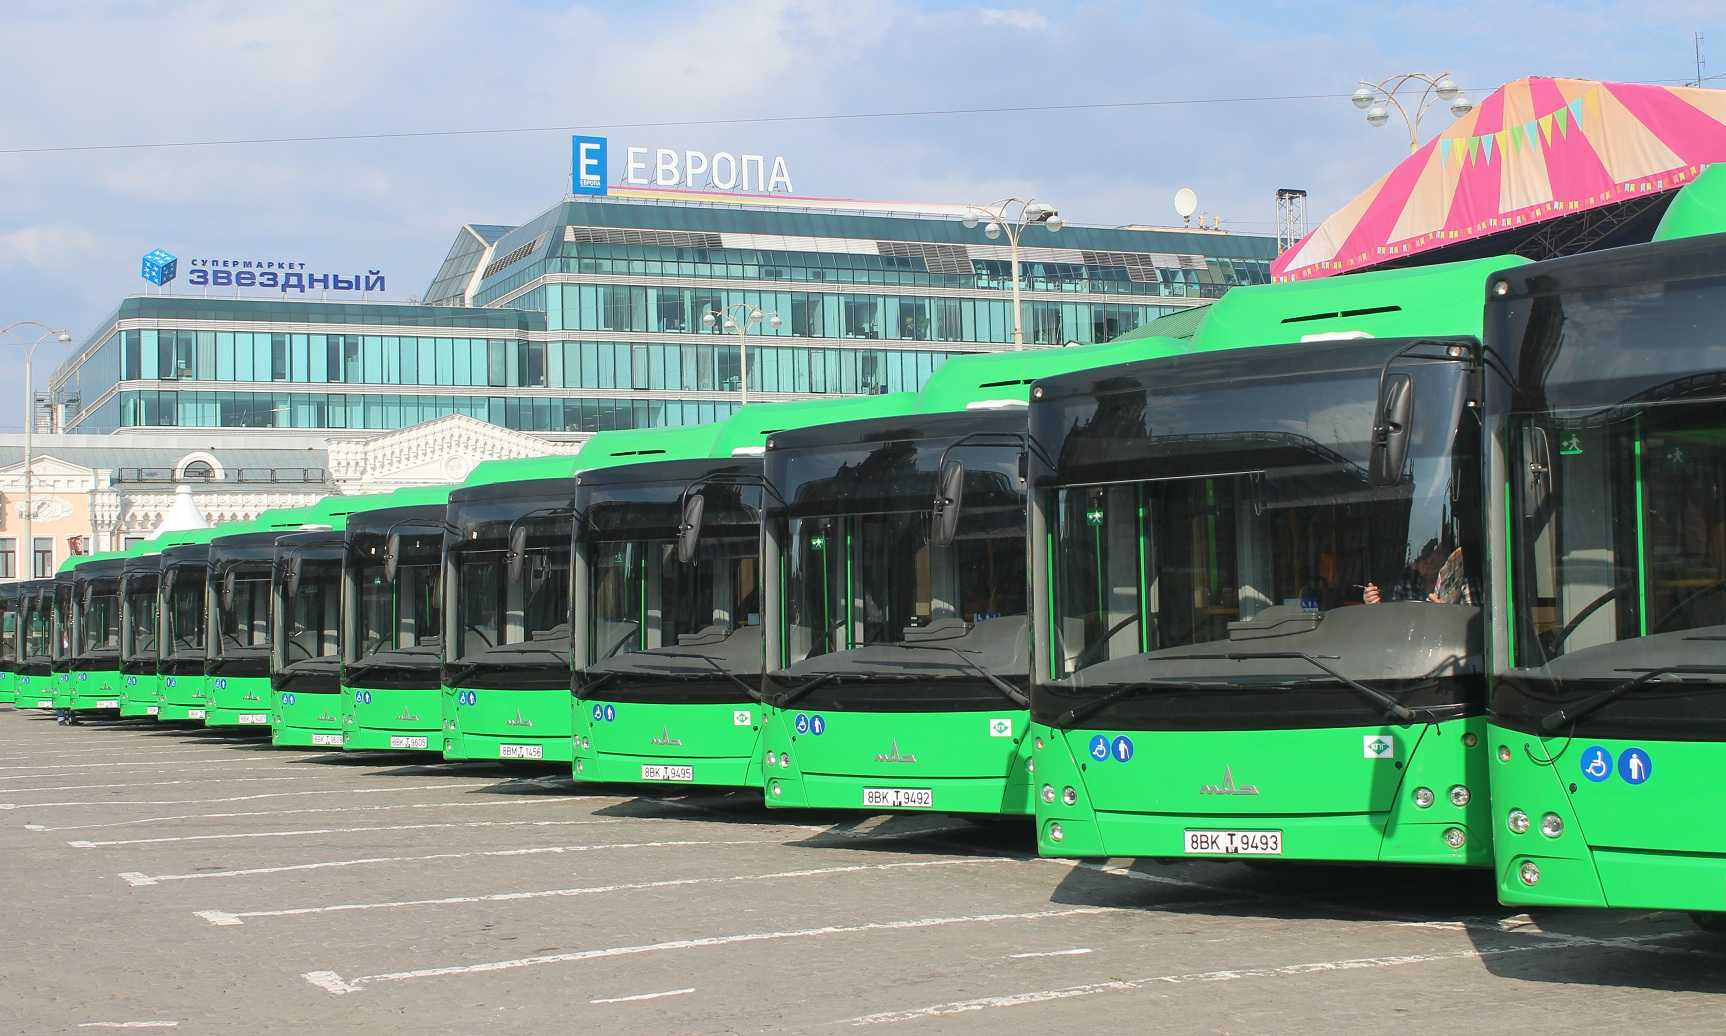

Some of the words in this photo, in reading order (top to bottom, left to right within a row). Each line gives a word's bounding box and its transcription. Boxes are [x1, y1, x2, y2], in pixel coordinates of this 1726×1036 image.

[580, 143, 600, 180] Е
[629, 147, 793, 192] ЕВРОПА
[191, 258, 306, 270] СУПЕРМАРКЕТ
[526, 748, 541, 757] 1456
[671, 768, 691, 778] 9495
[903, 791, 930, 804] 9492
[1240, 834, 1278, 851] 9493
